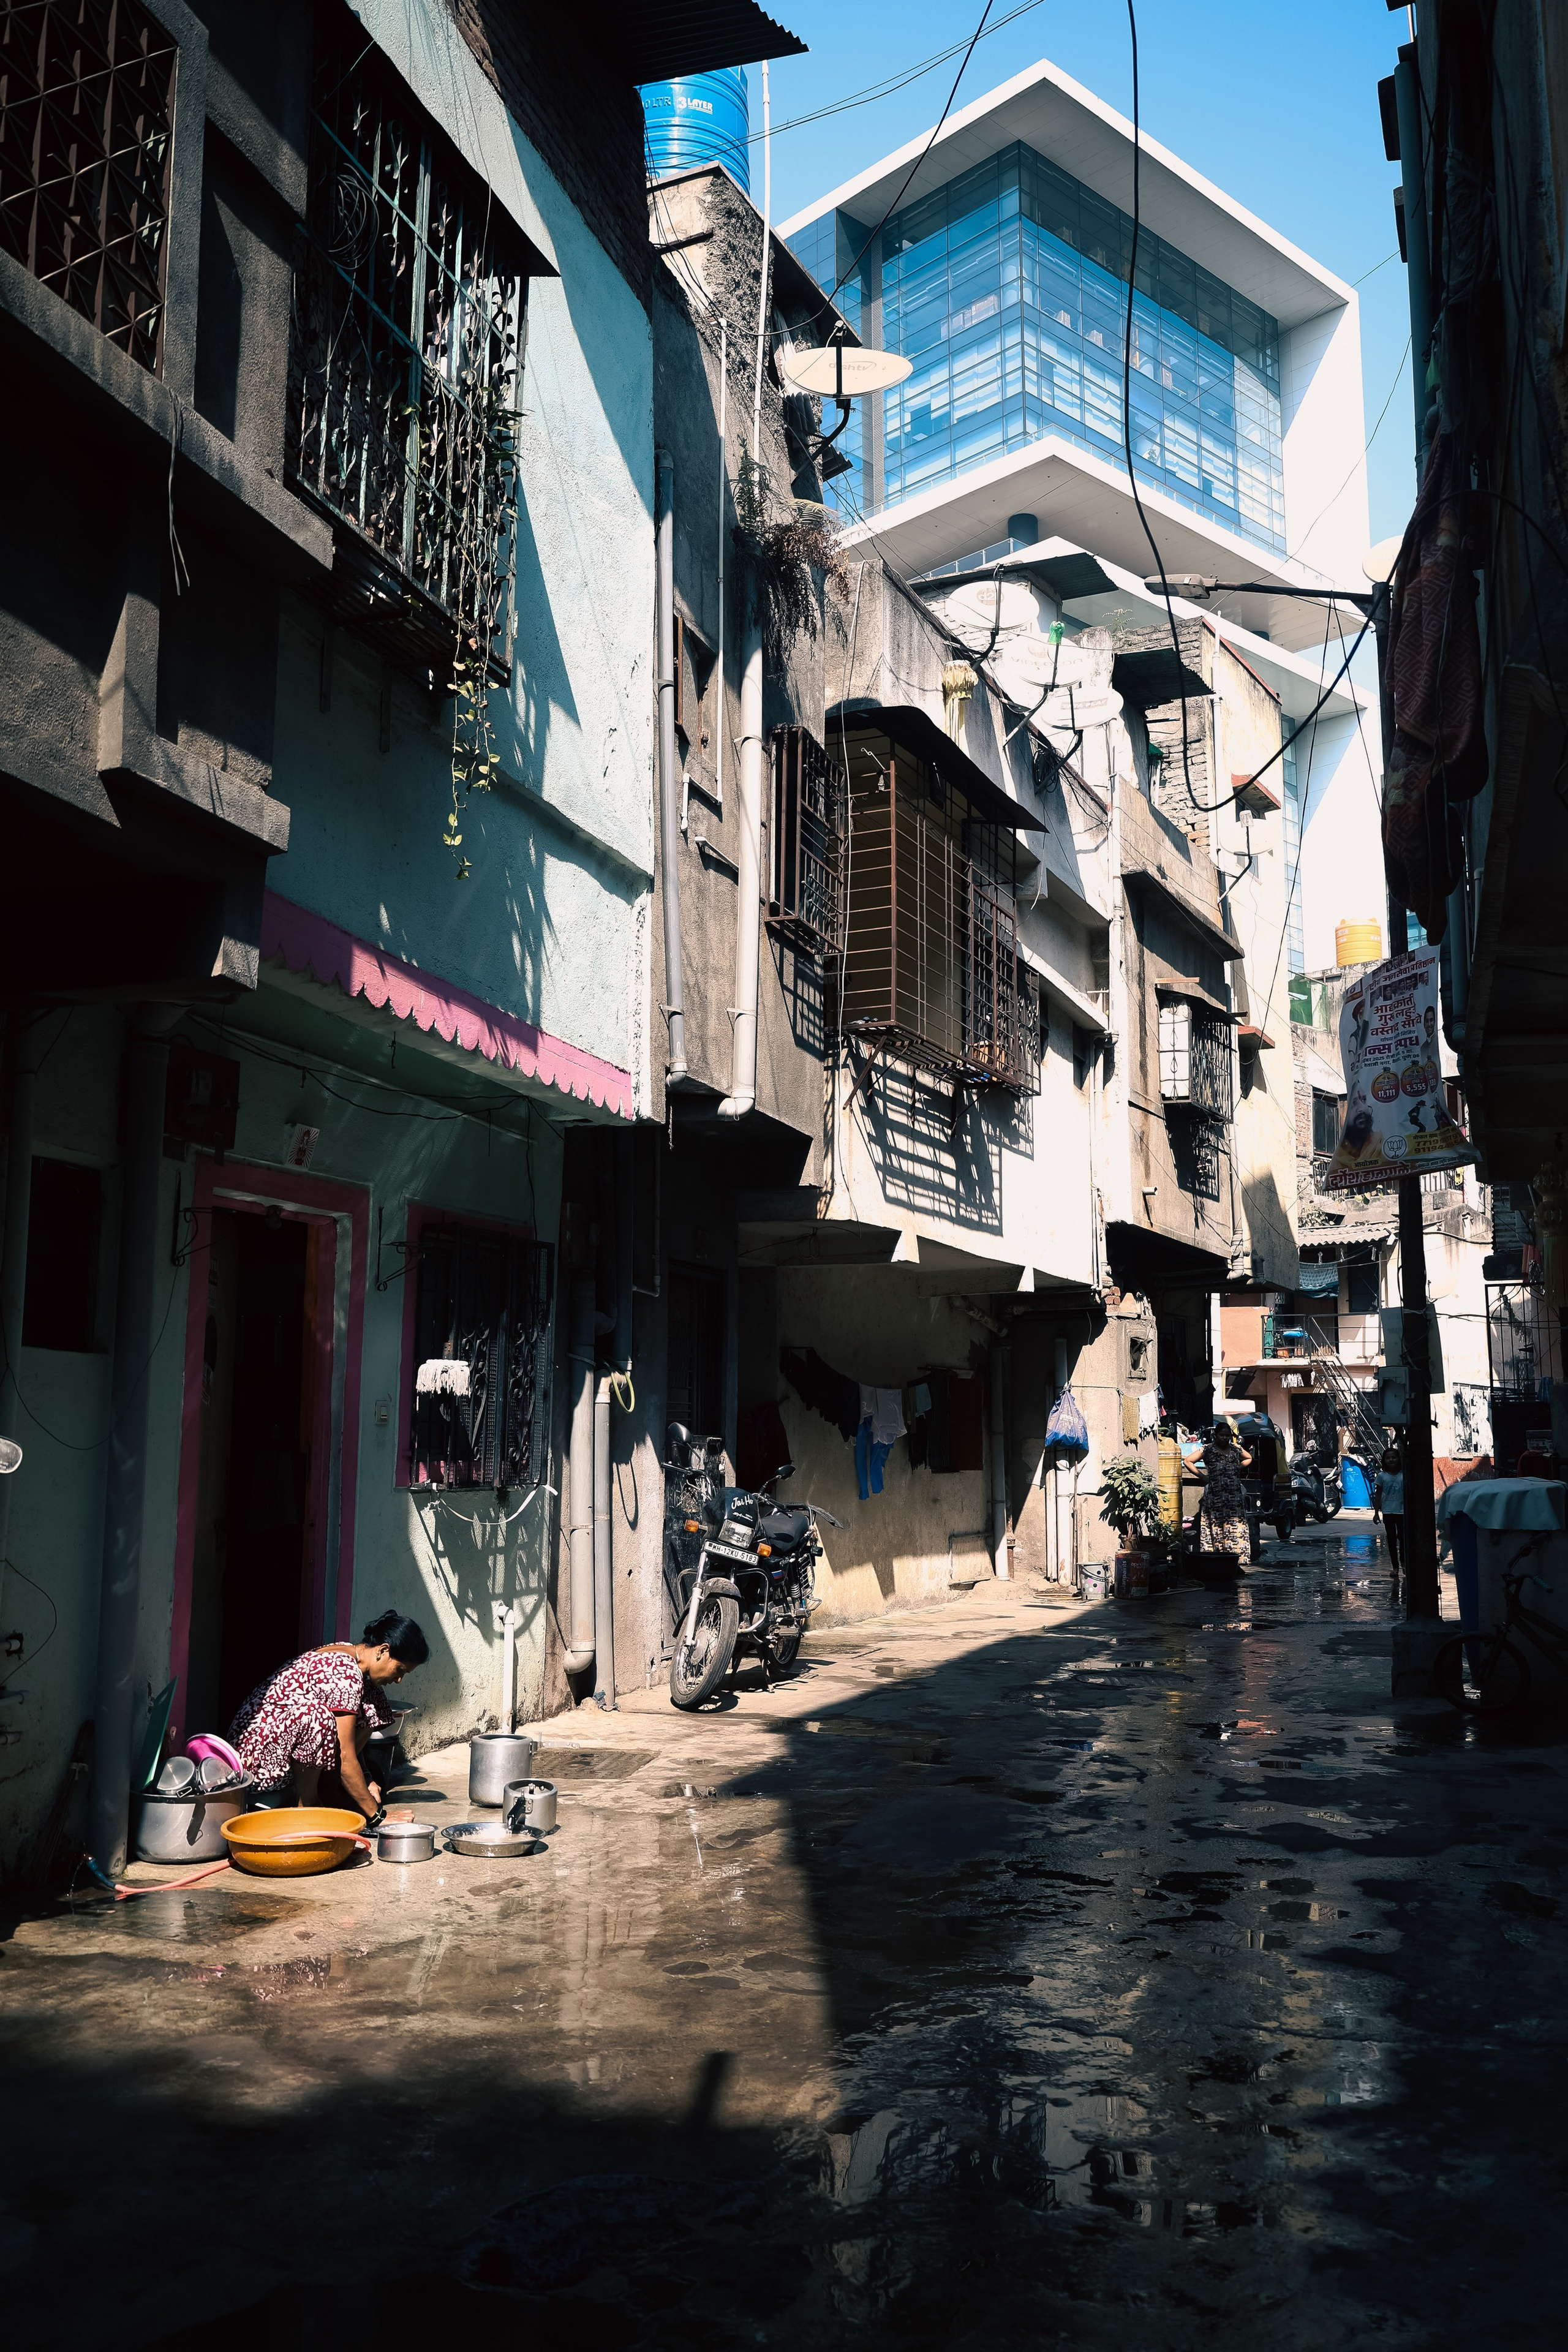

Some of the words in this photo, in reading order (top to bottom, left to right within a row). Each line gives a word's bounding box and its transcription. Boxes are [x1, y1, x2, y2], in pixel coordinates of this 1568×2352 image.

[652, 96, 671, 108] LTR
[677, 96, 687, 109] 3
[687, 97, 713, 111] LAYER
[829, 362, 874, 371] dshtv
[1011, 657, 1083, 666] VIDEOON
[1382, 966, 1409, 982] जनसेवा
[1401, 1012, 1422, 1028] सावे
[1378, 1088, 1395, 1098] 11,111
[1406, 1083, 1426, 1092] 5,555
[1354, 1159, 1379, 1168] आयोजक
[731, 1497, 745, 1510] Jai
[744, 1494, 754, 1506] Ho
